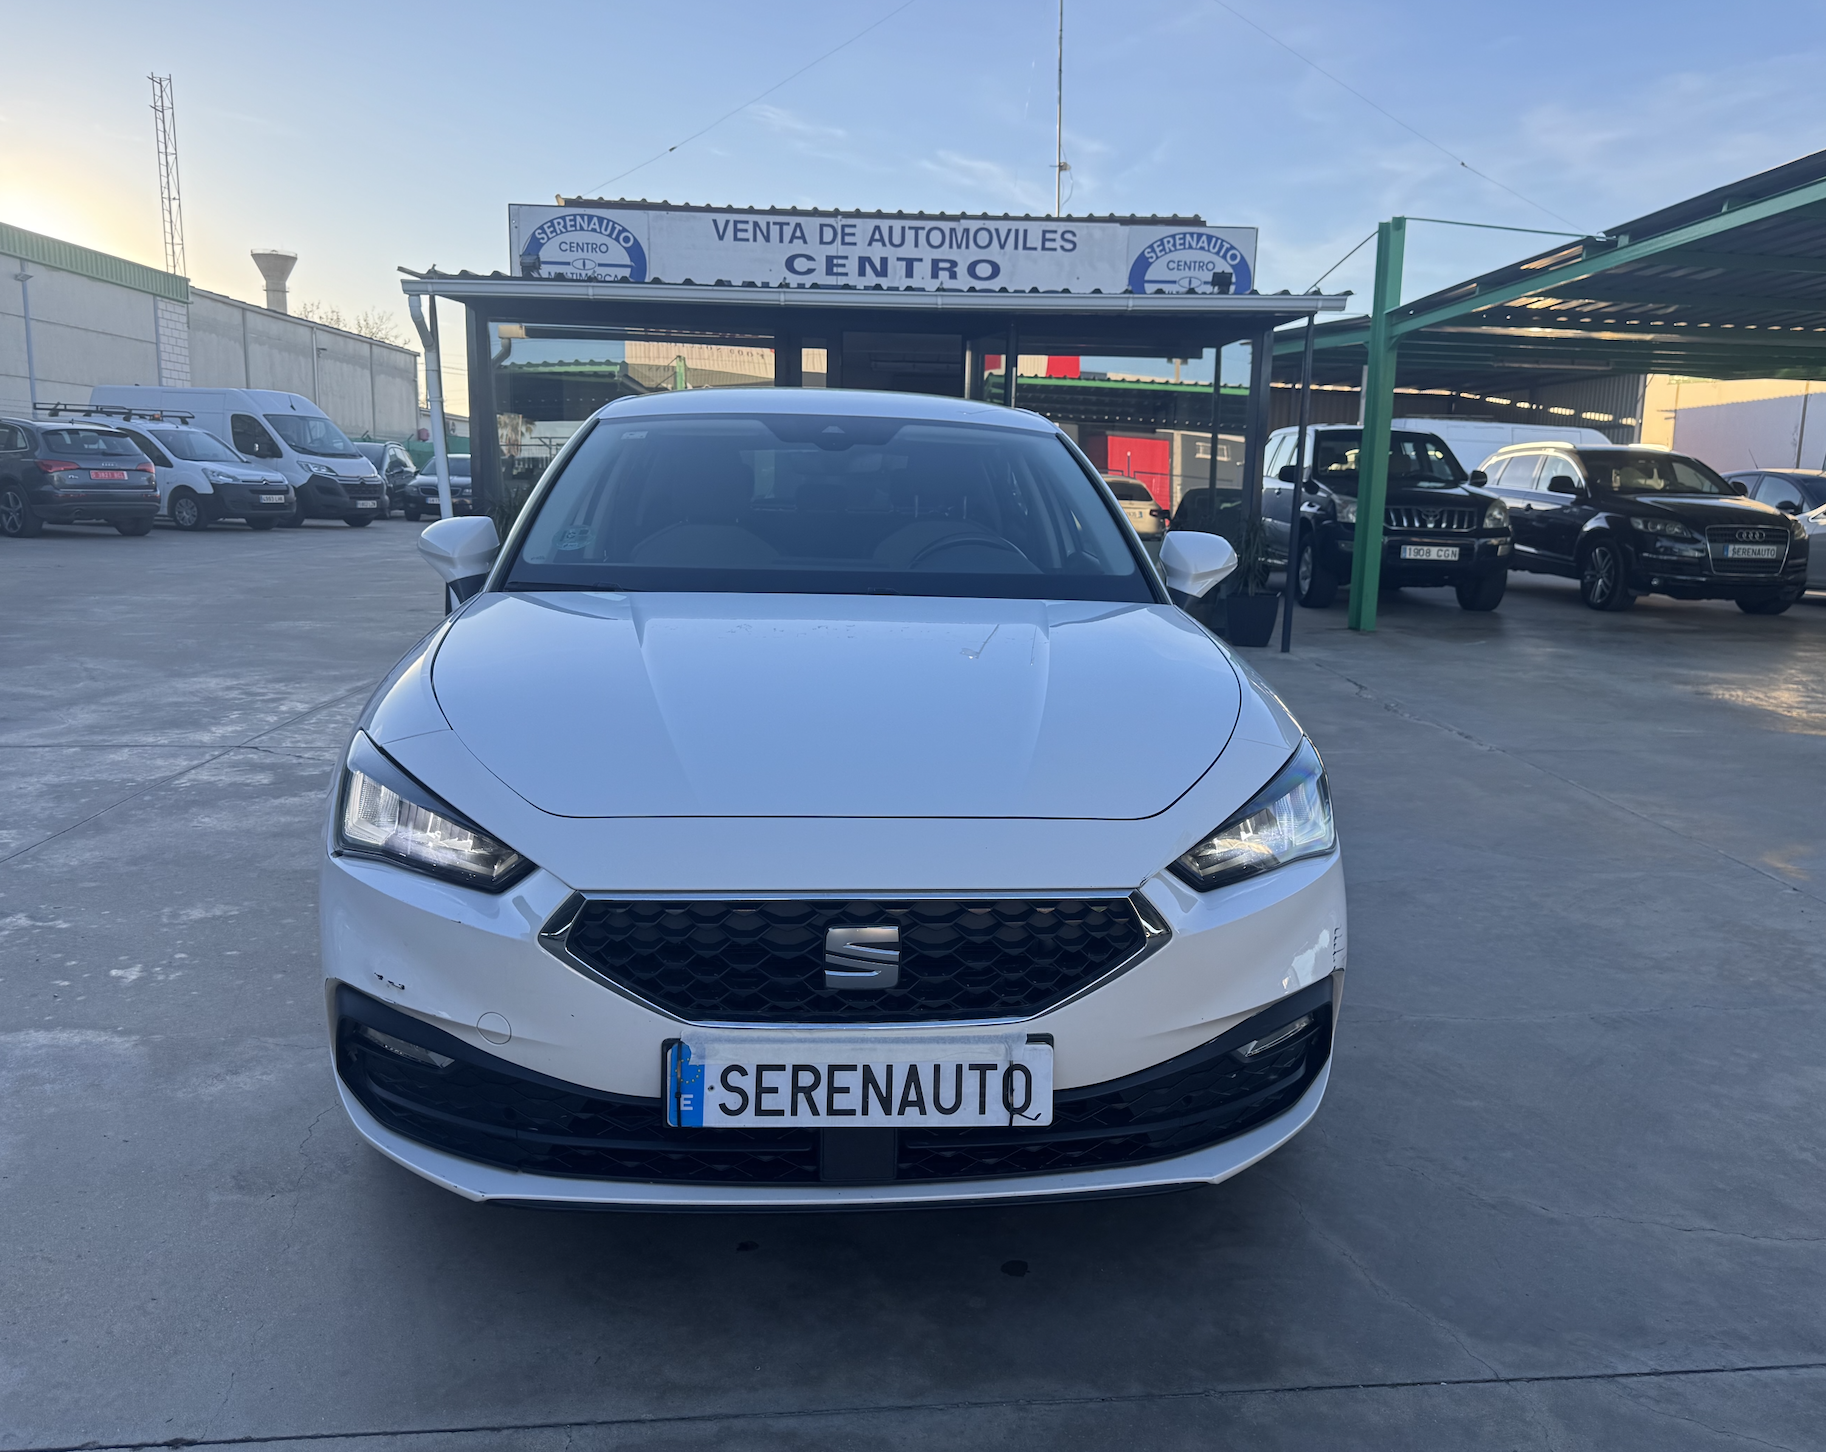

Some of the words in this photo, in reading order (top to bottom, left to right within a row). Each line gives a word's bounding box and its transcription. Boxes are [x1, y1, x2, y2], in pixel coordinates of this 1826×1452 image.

[535, 215, 634, 248] SERENAUTO
[712, 219, 808, 245] VENTA
[819, 223, 857, 246] DE
[867, 225, 1077, 252] AUTOMOVILES
[558, 241, 609, 254] CENTRO
[1144, 233, 1241, 265] SERENAUTO
[784, 253, 1001, 282] CENTRO
[1166, 260, 1216, 272] CENTRO
[1408, 547, 1431, 558] 1908
[1436, 548, 1457, 559] CGN
[1732, 546, 1776, 557] SERENAUTO
[679, 1094, 694, 1111] E
[718, 1064, 1032, 1117] SERENAUTO
